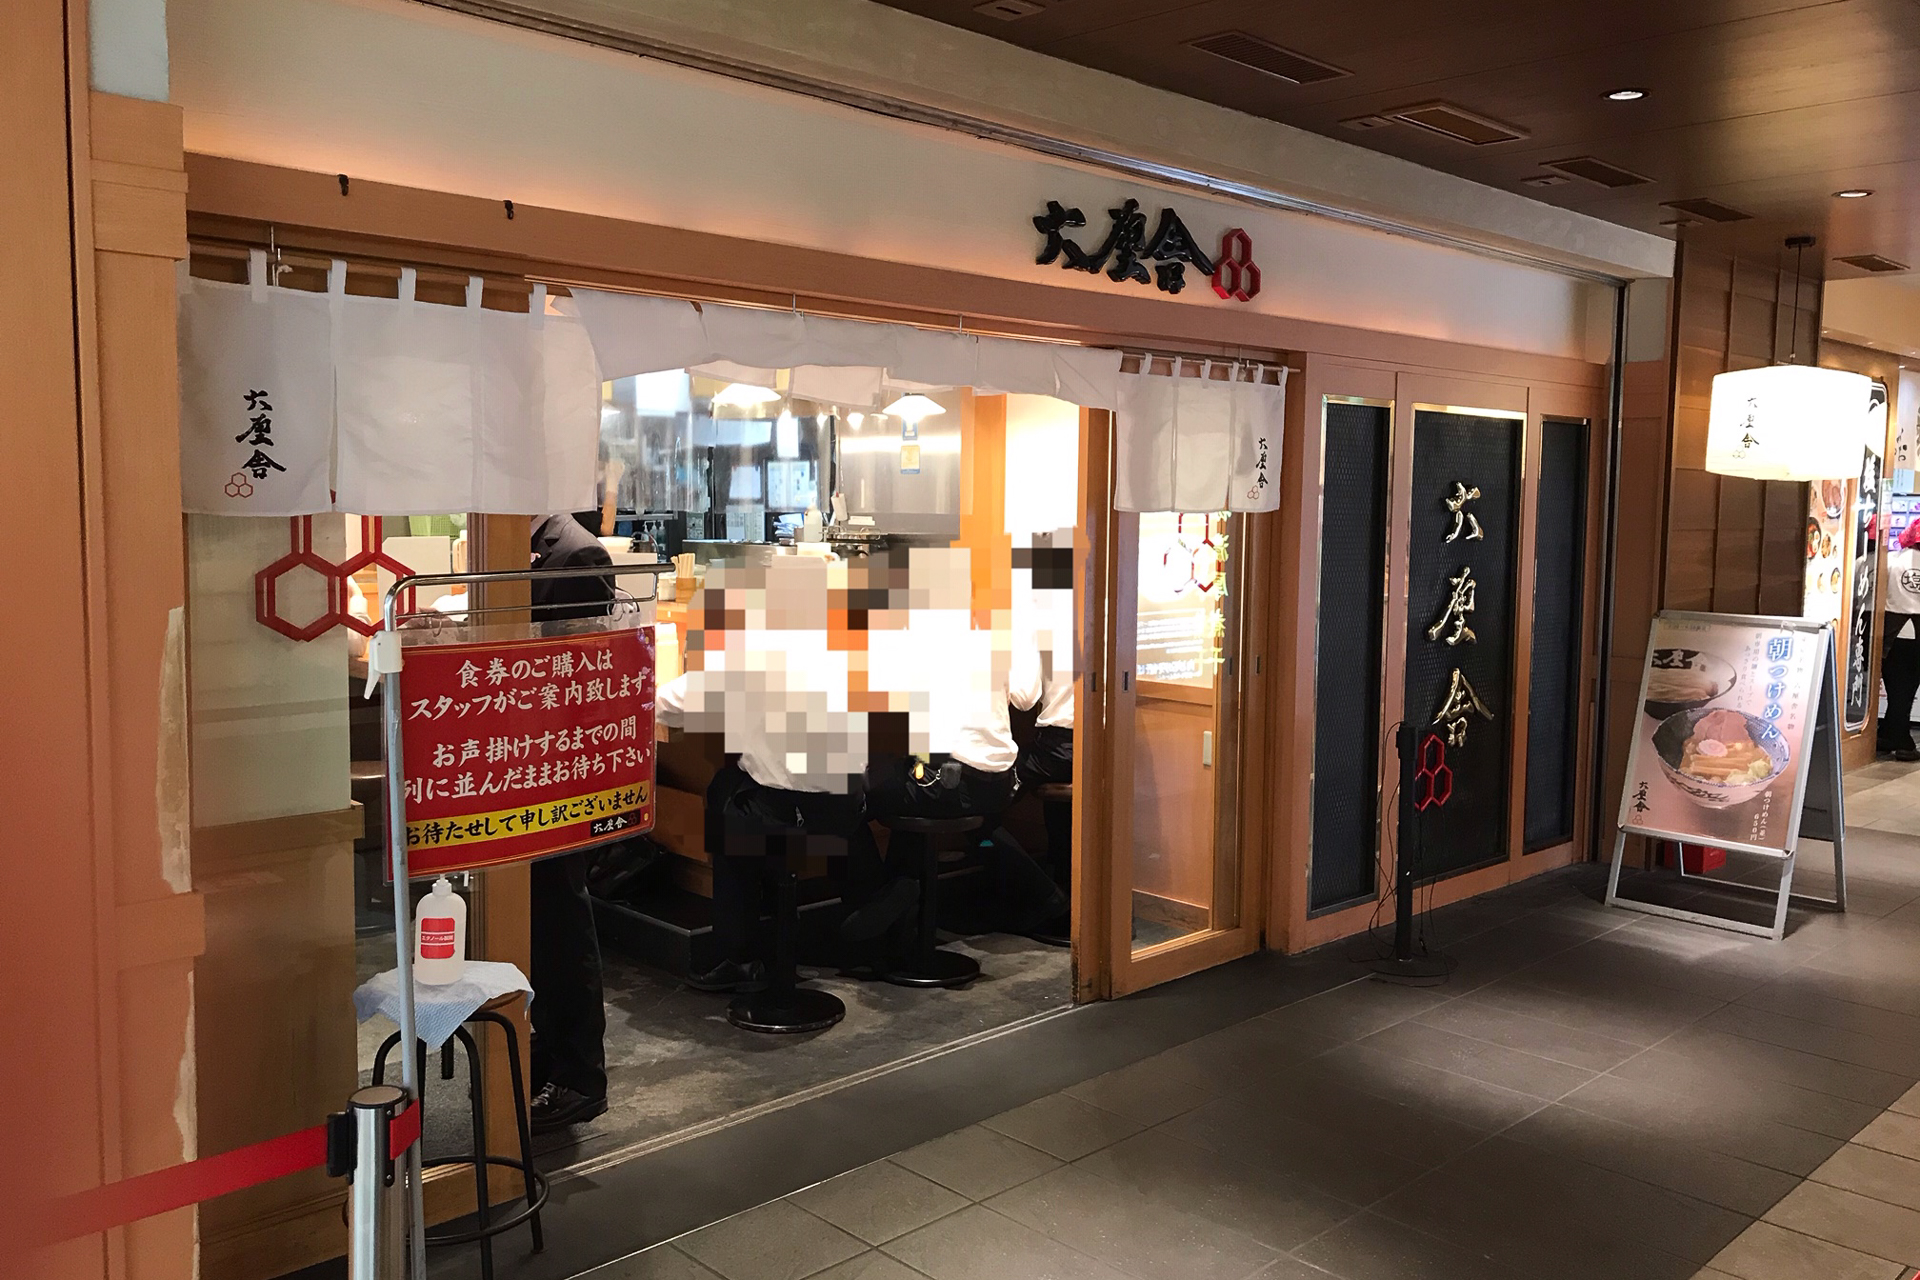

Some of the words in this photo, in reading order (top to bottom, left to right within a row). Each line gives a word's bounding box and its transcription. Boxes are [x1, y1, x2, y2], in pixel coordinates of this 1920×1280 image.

[408, 671, 648, 721] スタッフがご案内致します
[455, 649, 614, 689] 食券のご購入は
[1760, 637, 1794, 740] 朝つけめん
[432, 715, 638, 769] お声掛けするまでの間
[403, 746, 651, 804] 列に並んだままお待ち下さい
[405, 785, 648, 847] お待たせして申し訳ございません
